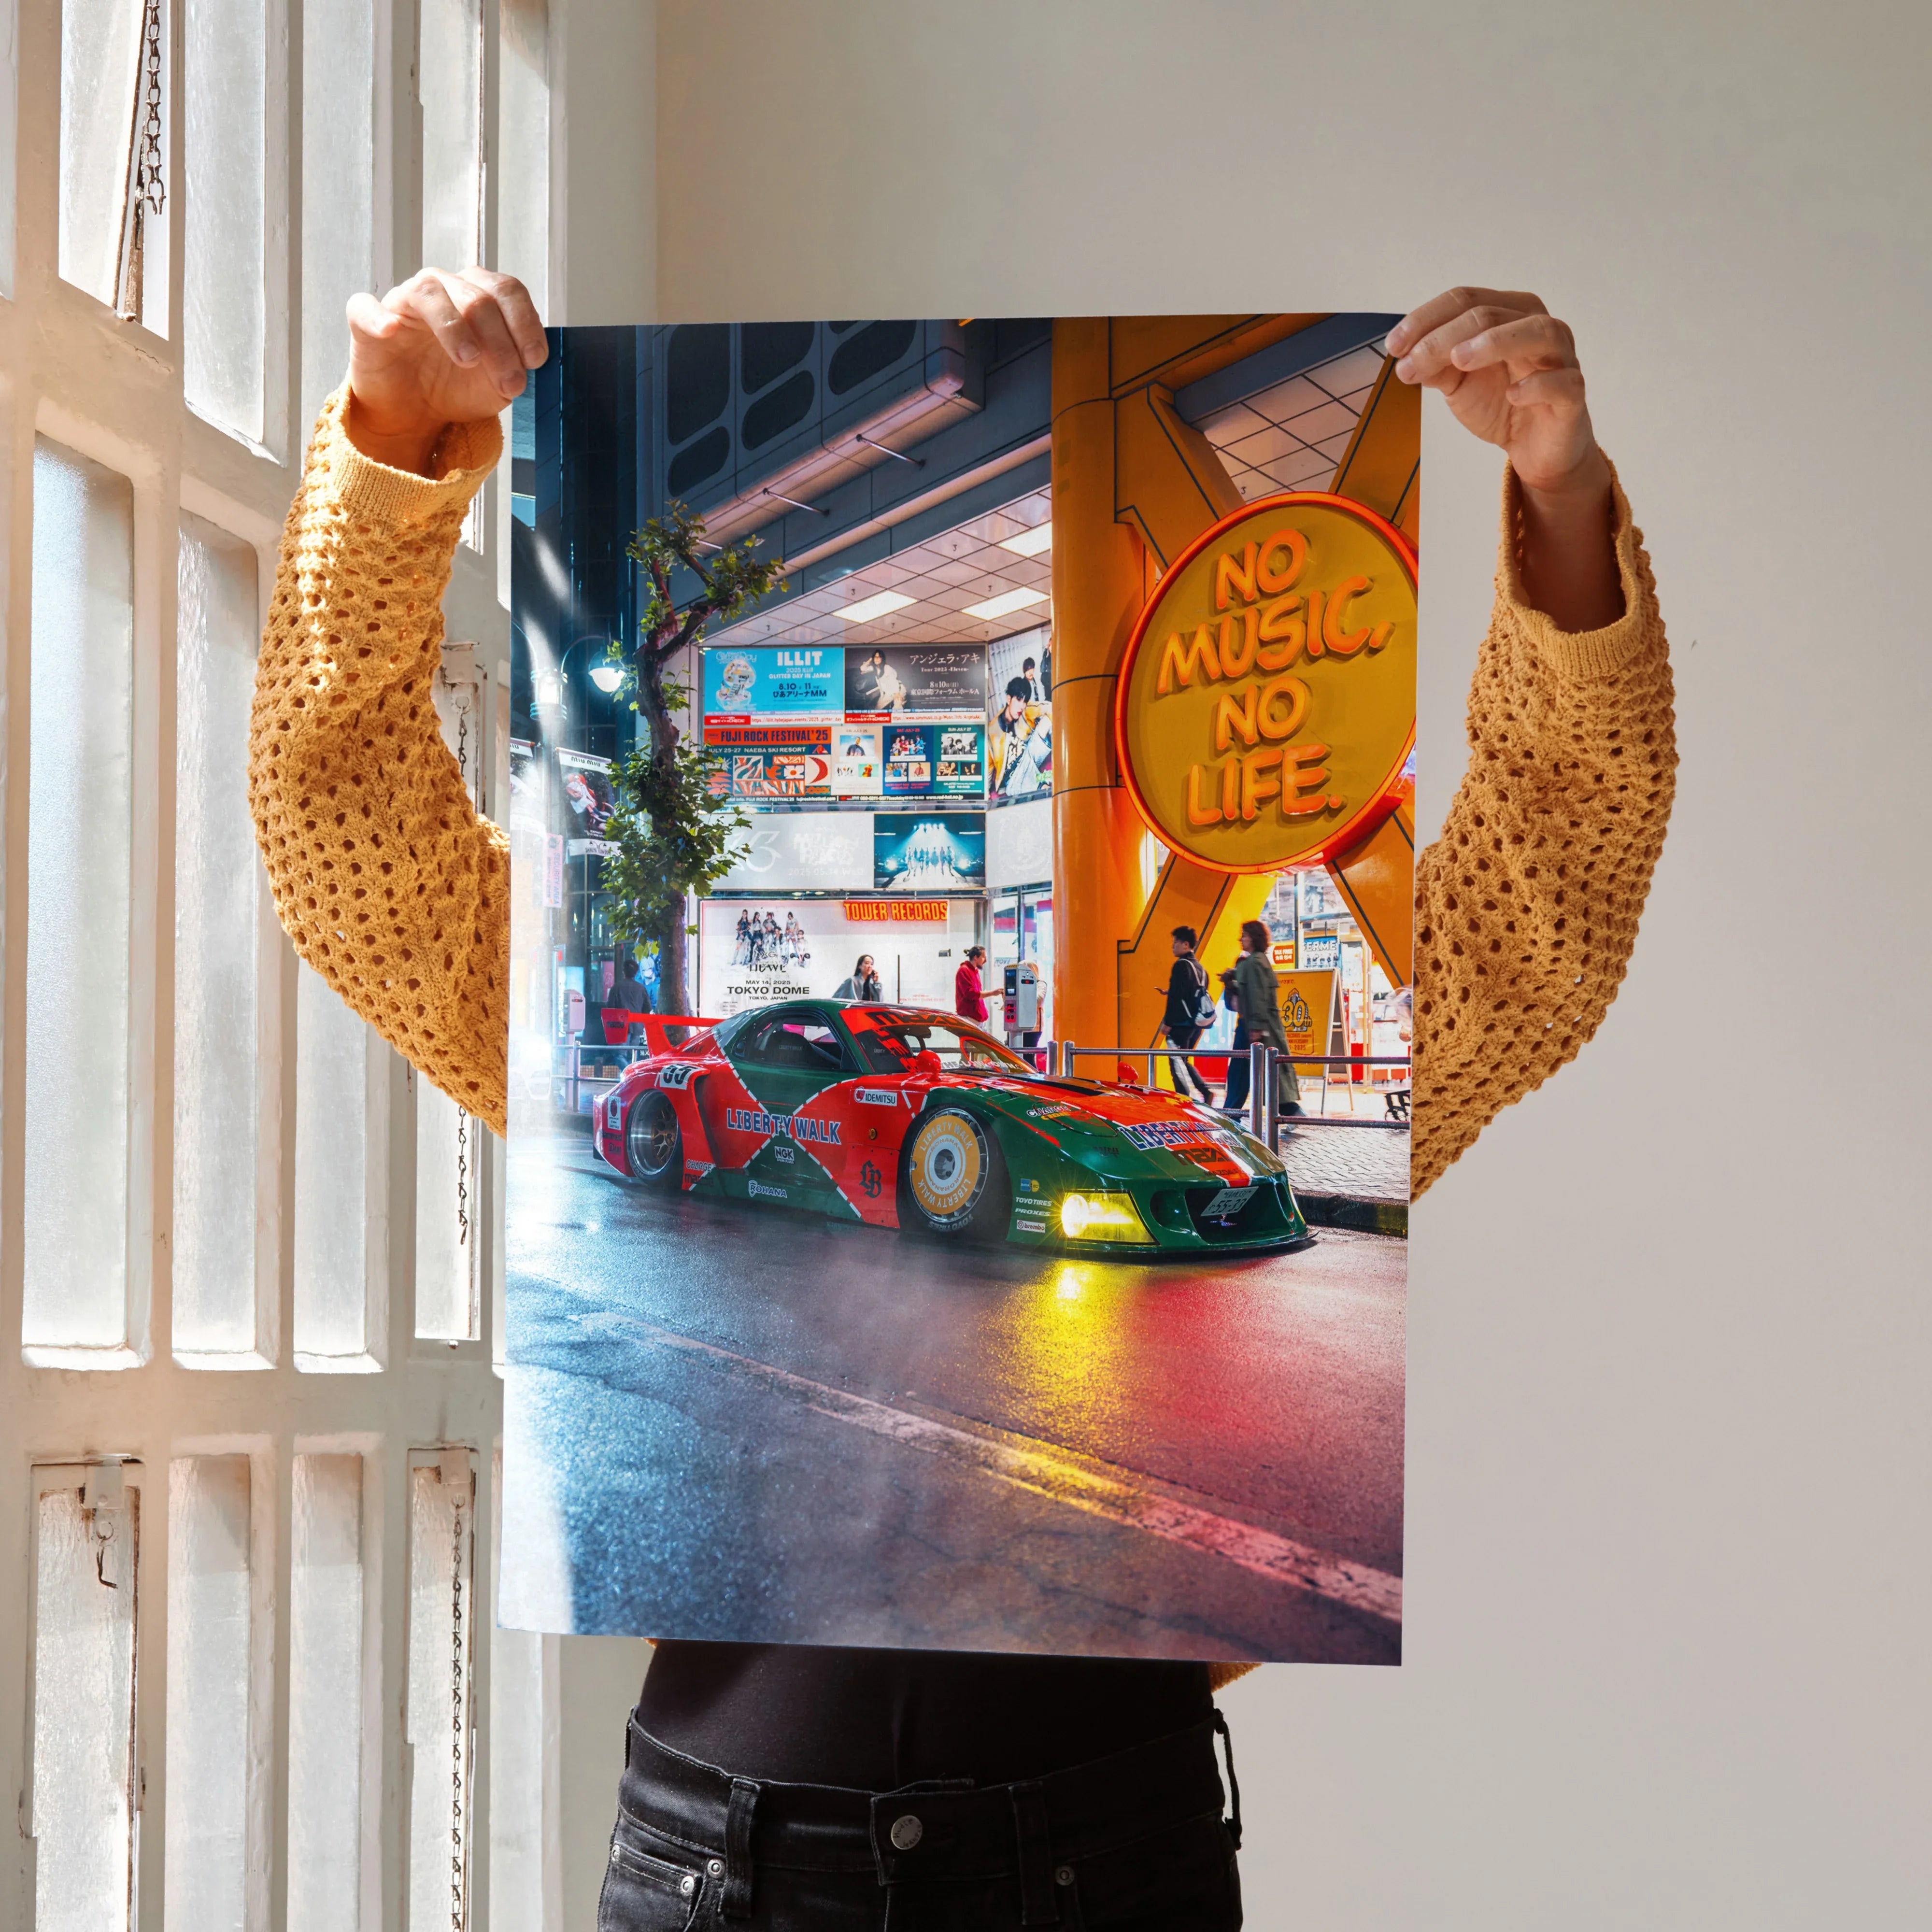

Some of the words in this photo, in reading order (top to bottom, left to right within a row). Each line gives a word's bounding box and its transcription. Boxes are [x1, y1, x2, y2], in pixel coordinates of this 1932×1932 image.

[1217, 529, 1306, 609] NO
[1158, 576, 1393, 694] MUSIC,
[777, 651, 823, 666] ILLIT
[910, 653, 980, 665] アンジェラ・アキ
[1217, 677, 1306, 750] NO
[721, 731, 741, 742] FUJI
[744, 731, 768, 741] ROCK
[1189, 744, 1342, 825] LIFE.
[844, 902, 889, 921] TOWER
[891, 902, 948, 921] RECORDS
[727, 986, 769, 994] TOKYO
[1281, 1000, 1313, 1028] 30th
[663, 1064, 697, 1085] 55
[865, 1093, 896, 1104] IDEMITSU
[1026, 1105, 1072, 1117] CHARGE
[726, 1108, 793, 1136] LIBERTY
[793, 1116, 841, 1144] WALK
[920, 1122, 952, 1151] LIBERTY
[953, 1124, 974, 1150] WALK
[776, 1148, 793, 1159] NGK
[686, 1159, 712, 1173] CHARGE
[750, 1183, 787, 1198] ROHANA
[918, 1179, 936, 1205] WALK
[938, 1179, 971, 1208] LIBERTY
[1015, 1208, 1051, 1216] PROXES
